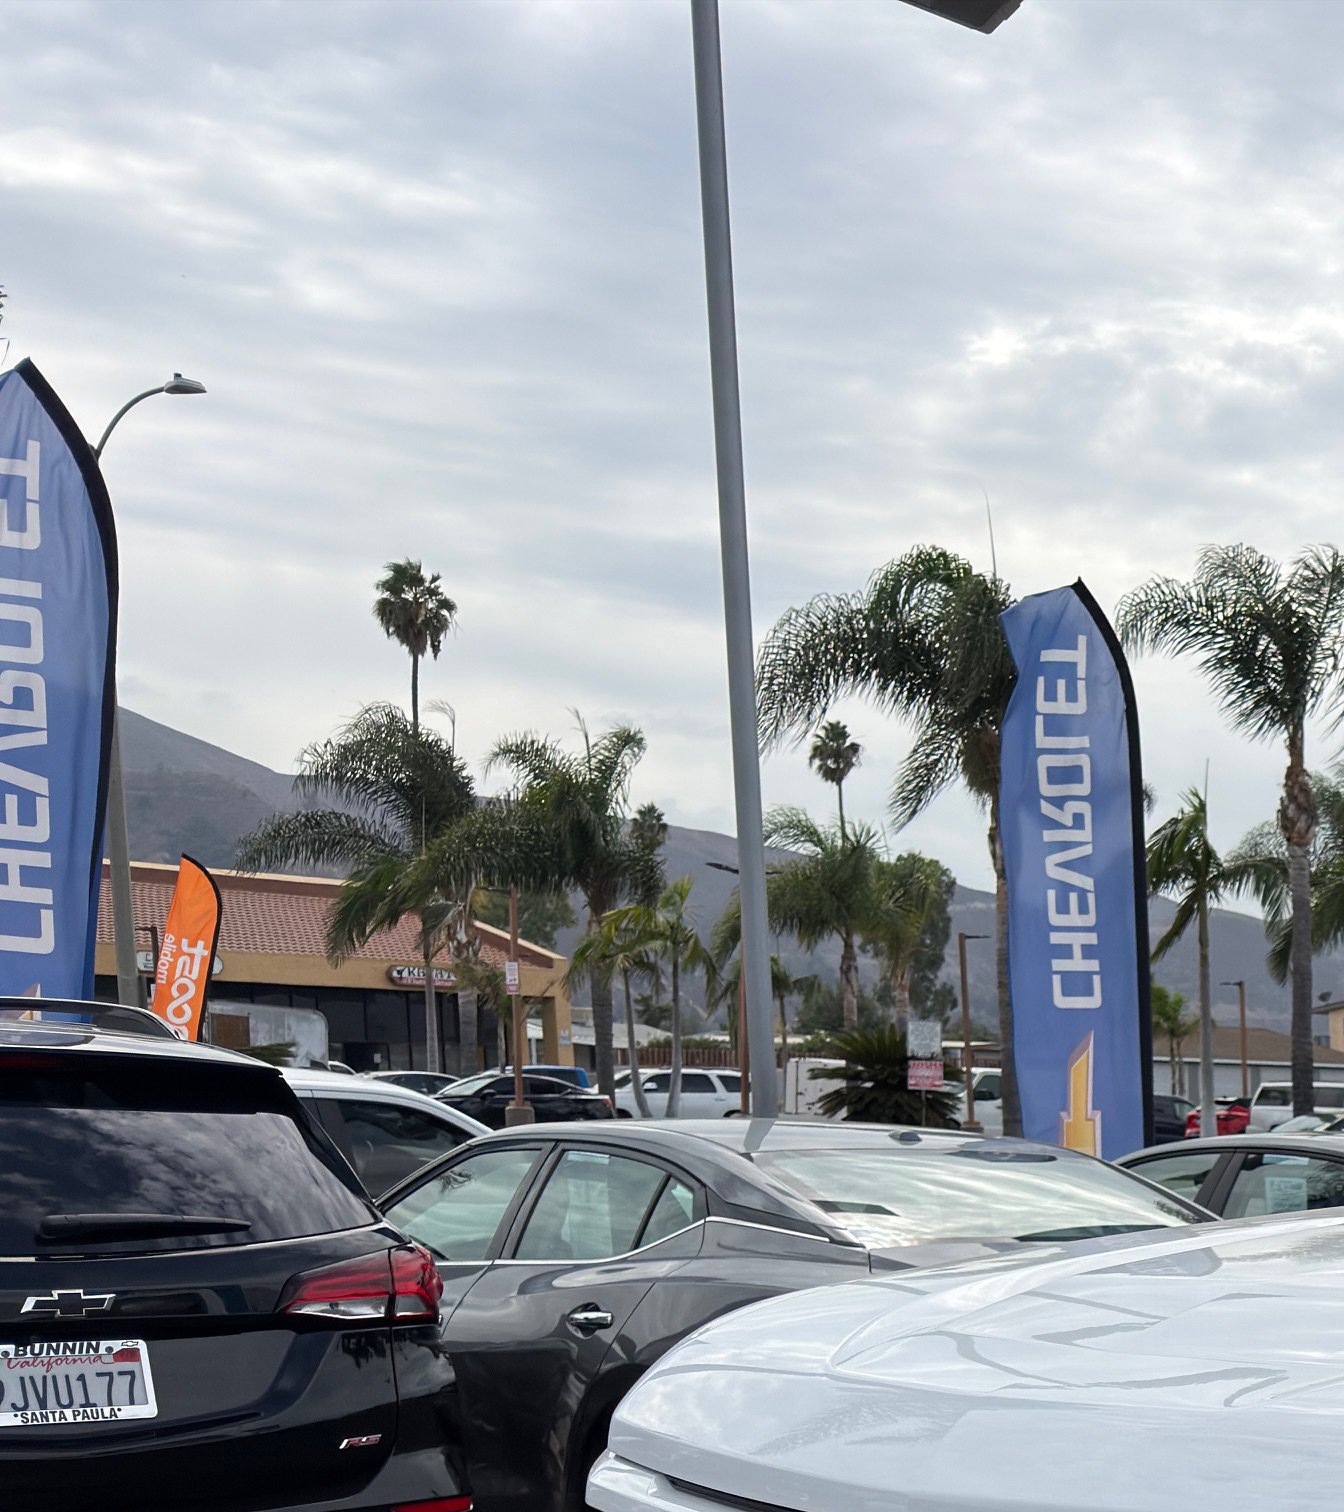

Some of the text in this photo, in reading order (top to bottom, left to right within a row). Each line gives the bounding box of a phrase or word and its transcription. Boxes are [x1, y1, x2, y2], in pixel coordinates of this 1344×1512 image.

[14, 1341, 101, 1357] BUNNIN
[7, 1354, 104, 1374] California
[20, 1407, 119, 1424] SANTA PAULA
[339, 1434, 382, 1450] RS
